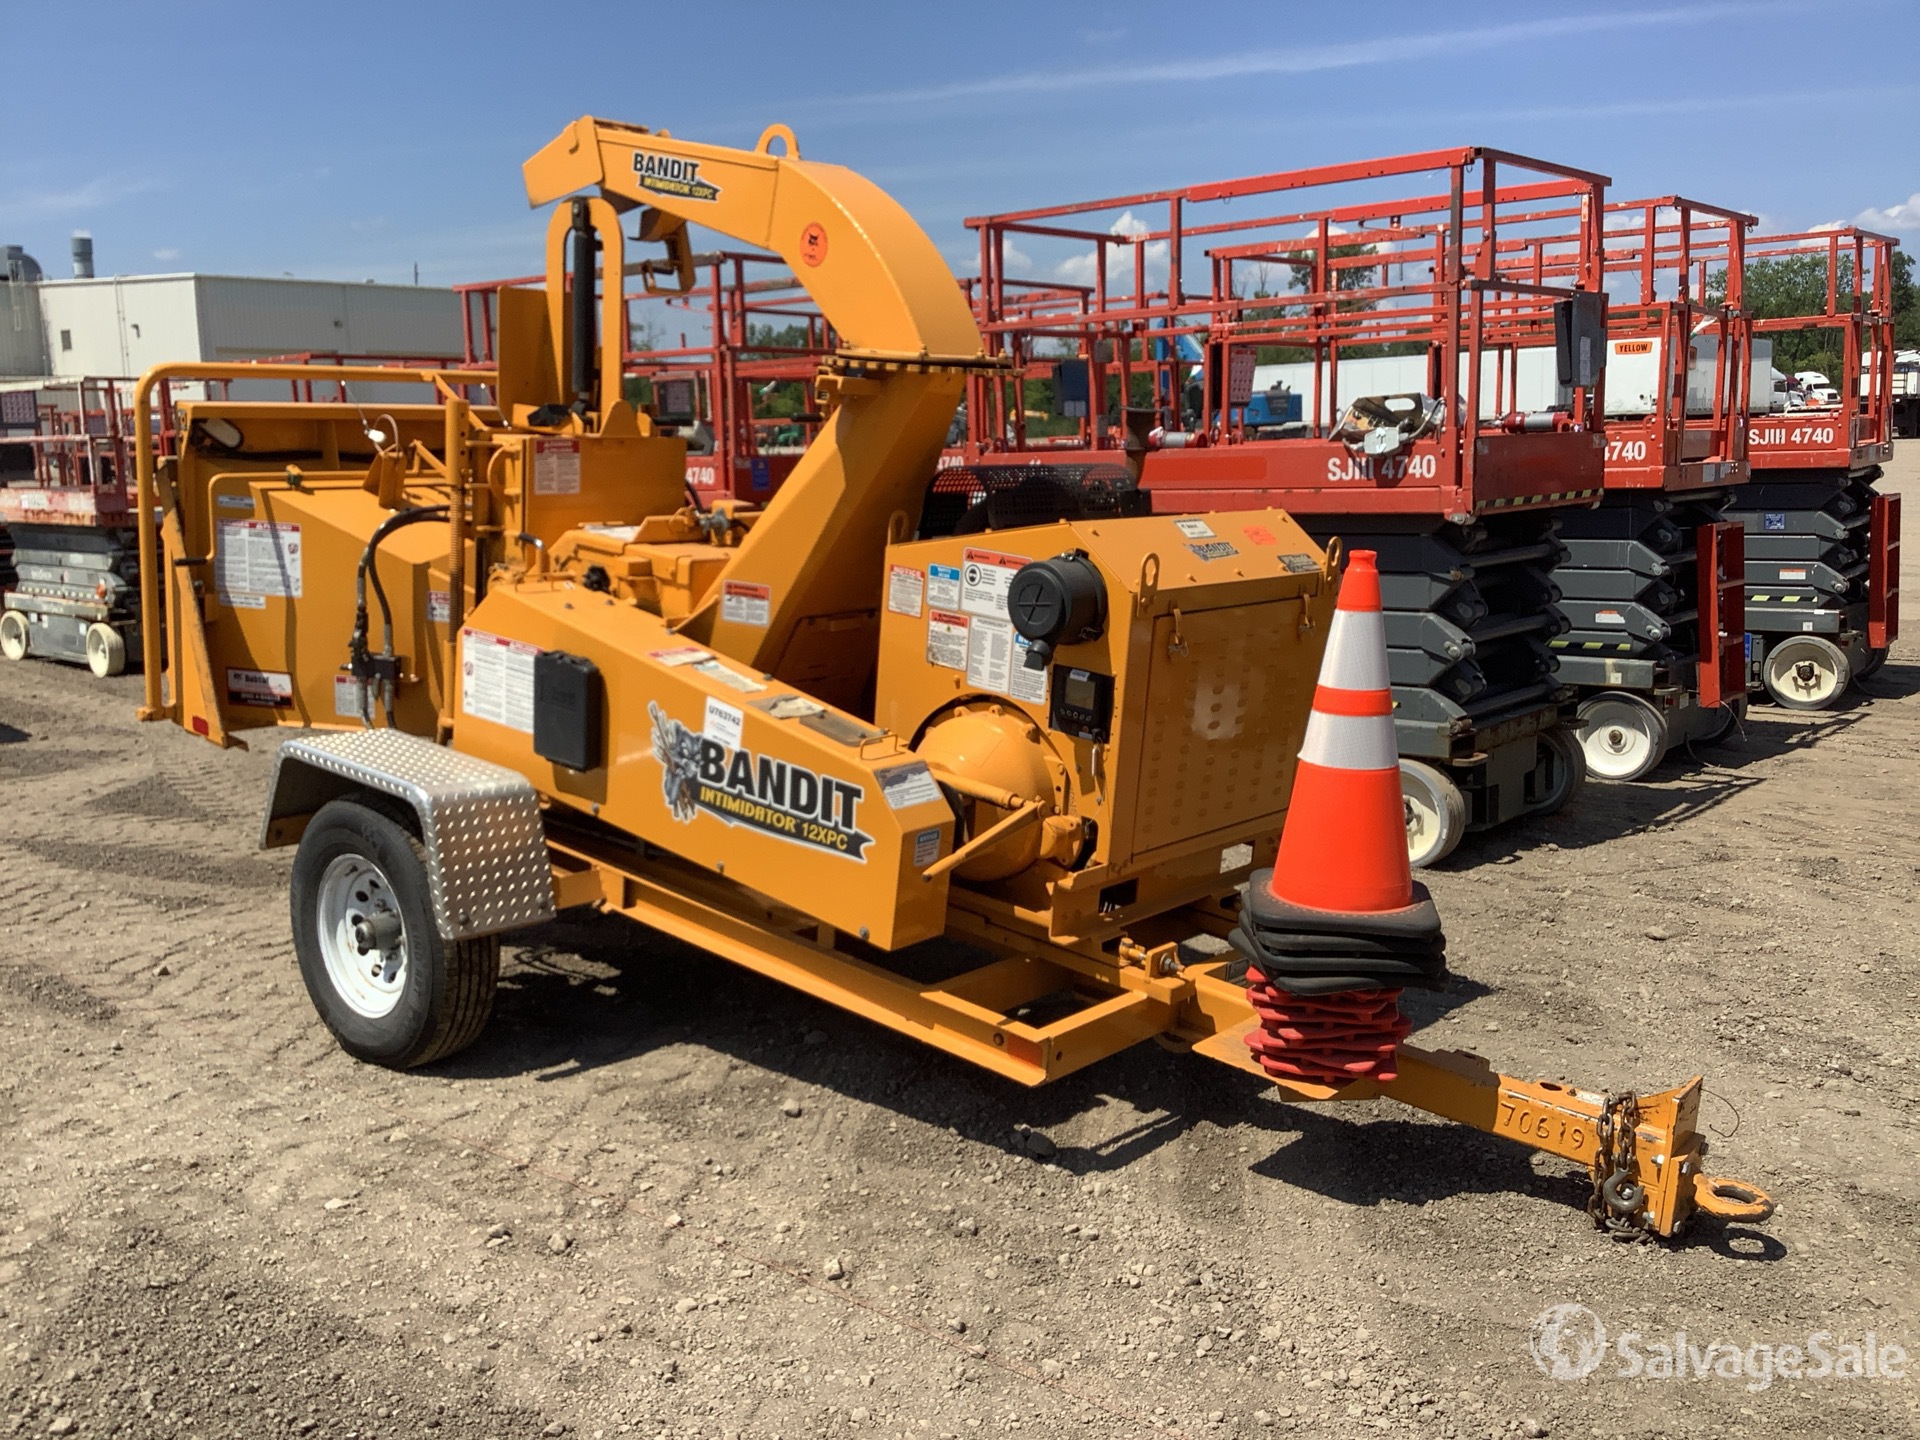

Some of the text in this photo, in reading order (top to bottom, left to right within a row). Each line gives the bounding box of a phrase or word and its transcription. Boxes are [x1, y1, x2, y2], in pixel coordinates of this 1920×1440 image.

[633, 152, 700, 182] BANDIT
[1619, 343, 1649, 353] YELLOW
[1790, 427, 1834, 445] 4740
[685, 466, 715, 485] 4740
[1381, 454, 1436, 479] 4740
[699, 737, 863, 832] BANDIT
[700, 785, 849, 850] INTIMIDATOR 12XPC
[1500, 1101, 1585, 1151] 70619
